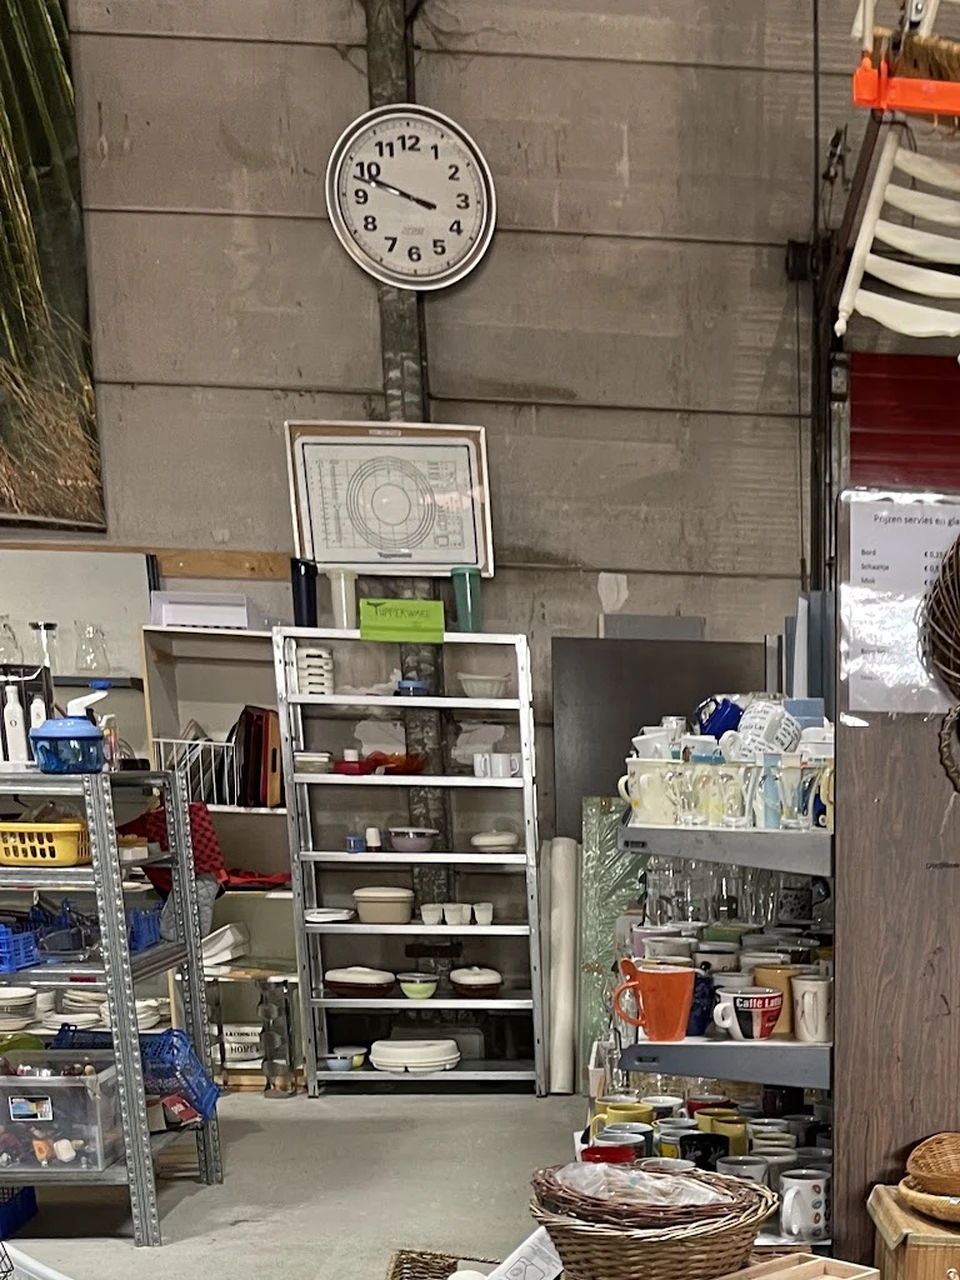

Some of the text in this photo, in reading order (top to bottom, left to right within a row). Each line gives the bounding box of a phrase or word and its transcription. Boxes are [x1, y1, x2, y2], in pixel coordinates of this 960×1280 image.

[374, 141, 395, 158] 11
[397, 134, 421, 152] 12
[431, 143, 439, 160] 1
[355, 161, 381, 180] 10
[448, 164, 460, 181] 2
[354, 188, 369, 205] 9
[456, 193, 470, 210] 3
[363, 215, 378, 232] 8
[449, 220, 464, 236] 4
[384, 236, 398, 253] 7
[432, 239, 446, 255] 5
[407, 246, 422, 262] 6
[873, 513, 903, 525] Prijzen
[904, 516, 933, 525] servies
[934, 517, 946, 525] en
